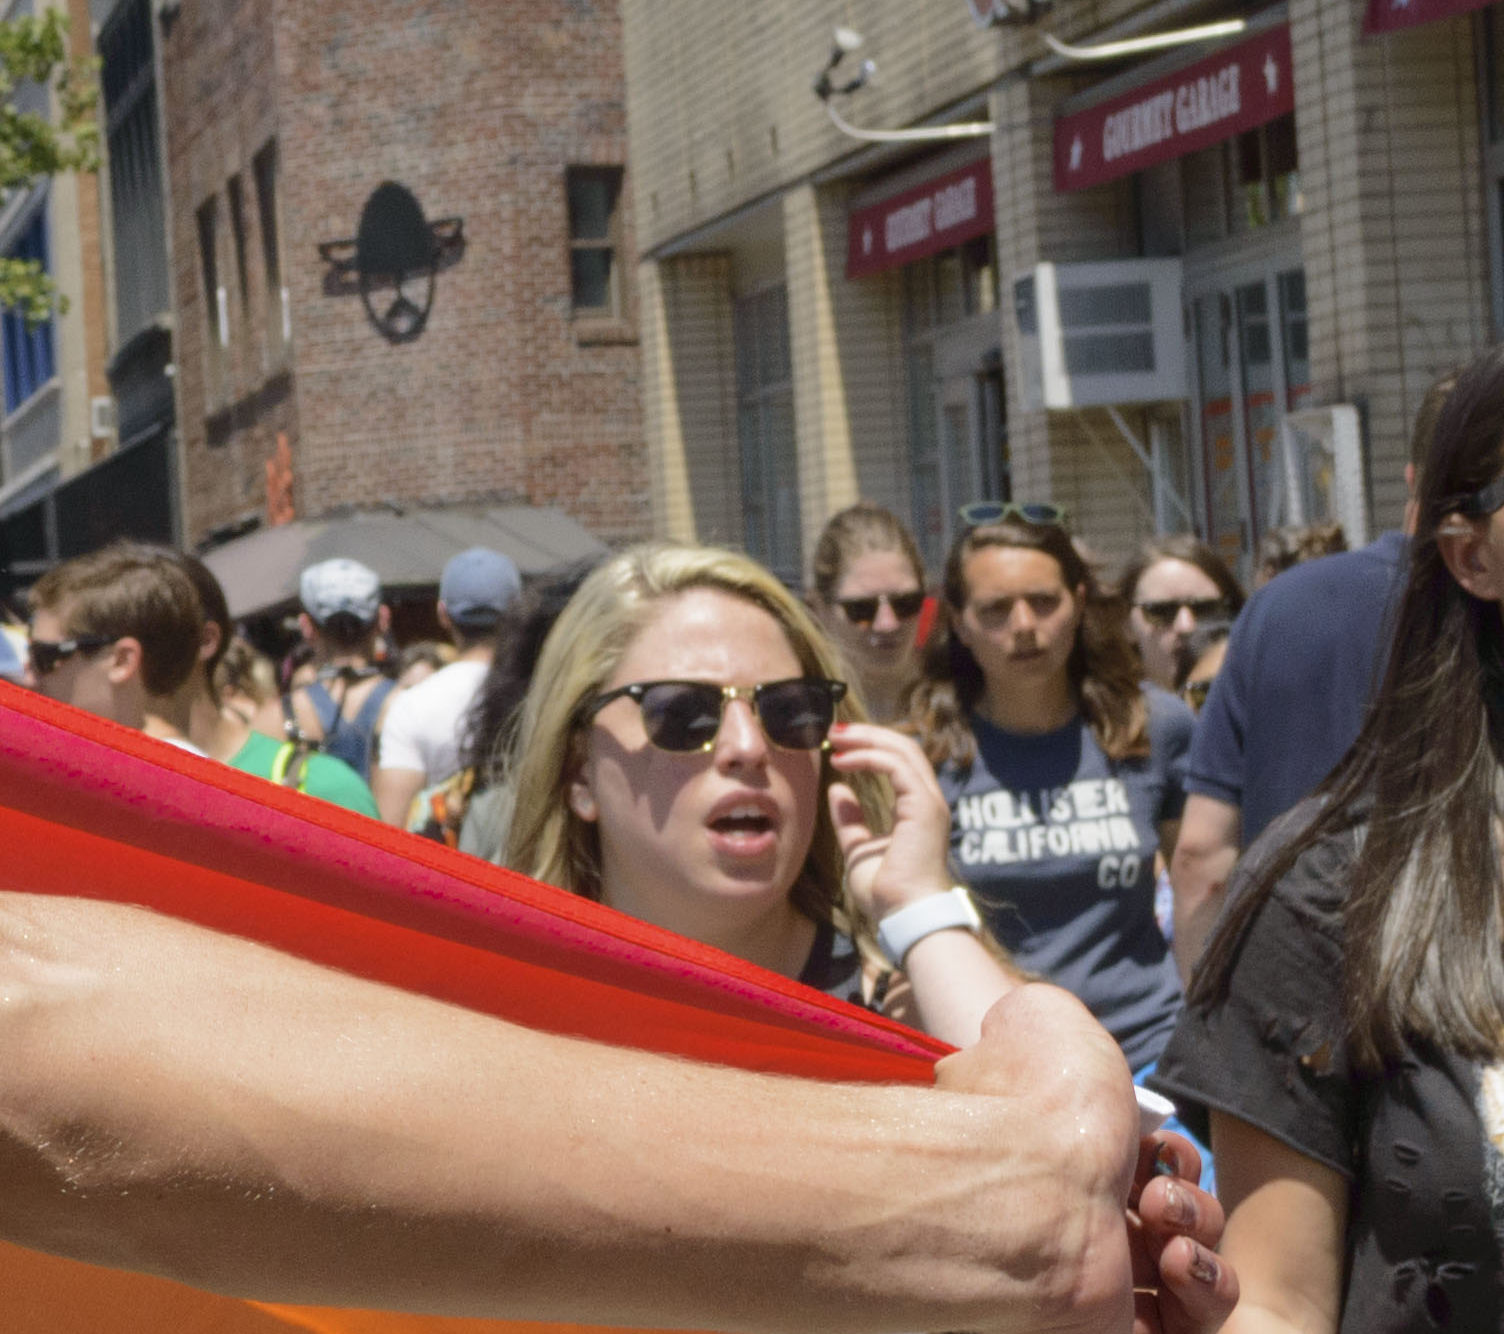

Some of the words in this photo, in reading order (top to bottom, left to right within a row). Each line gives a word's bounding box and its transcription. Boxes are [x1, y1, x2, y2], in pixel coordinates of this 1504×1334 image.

[957, 778, 1131, 831] HOLLISTER
[959, 817, 1139, 865] CALIFORNIA
[1097, 854, 1140, 889] CO
